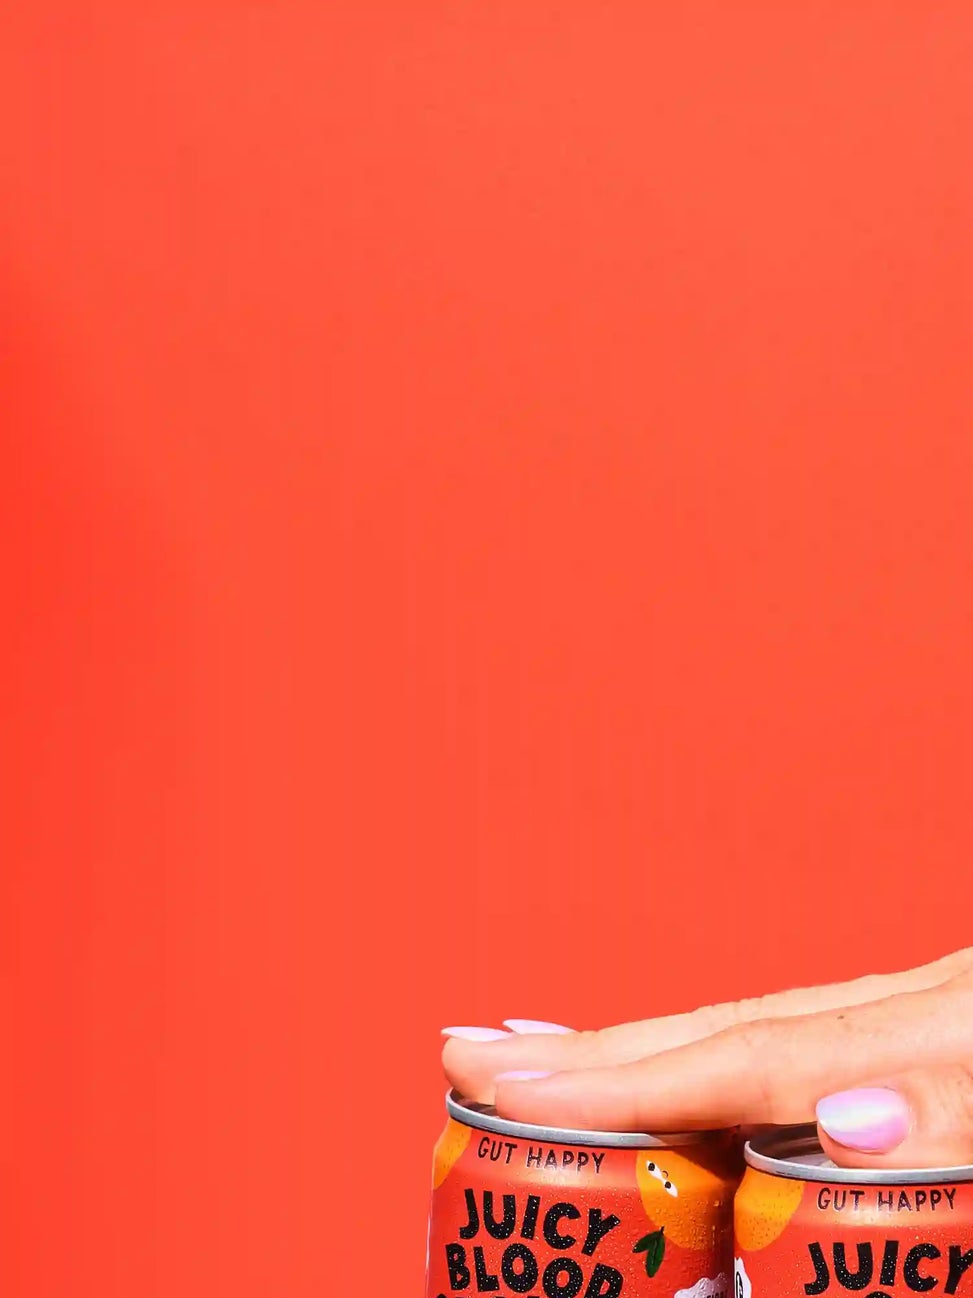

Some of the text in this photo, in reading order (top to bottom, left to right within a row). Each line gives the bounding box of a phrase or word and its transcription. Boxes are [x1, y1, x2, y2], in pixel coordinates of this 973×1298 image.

[478, 1137, 606, 1174] GUT HAPPY
[818, 1187, 957, 1212] GUT HAPPY
[460, 1189, 622, 1257] JUICY
